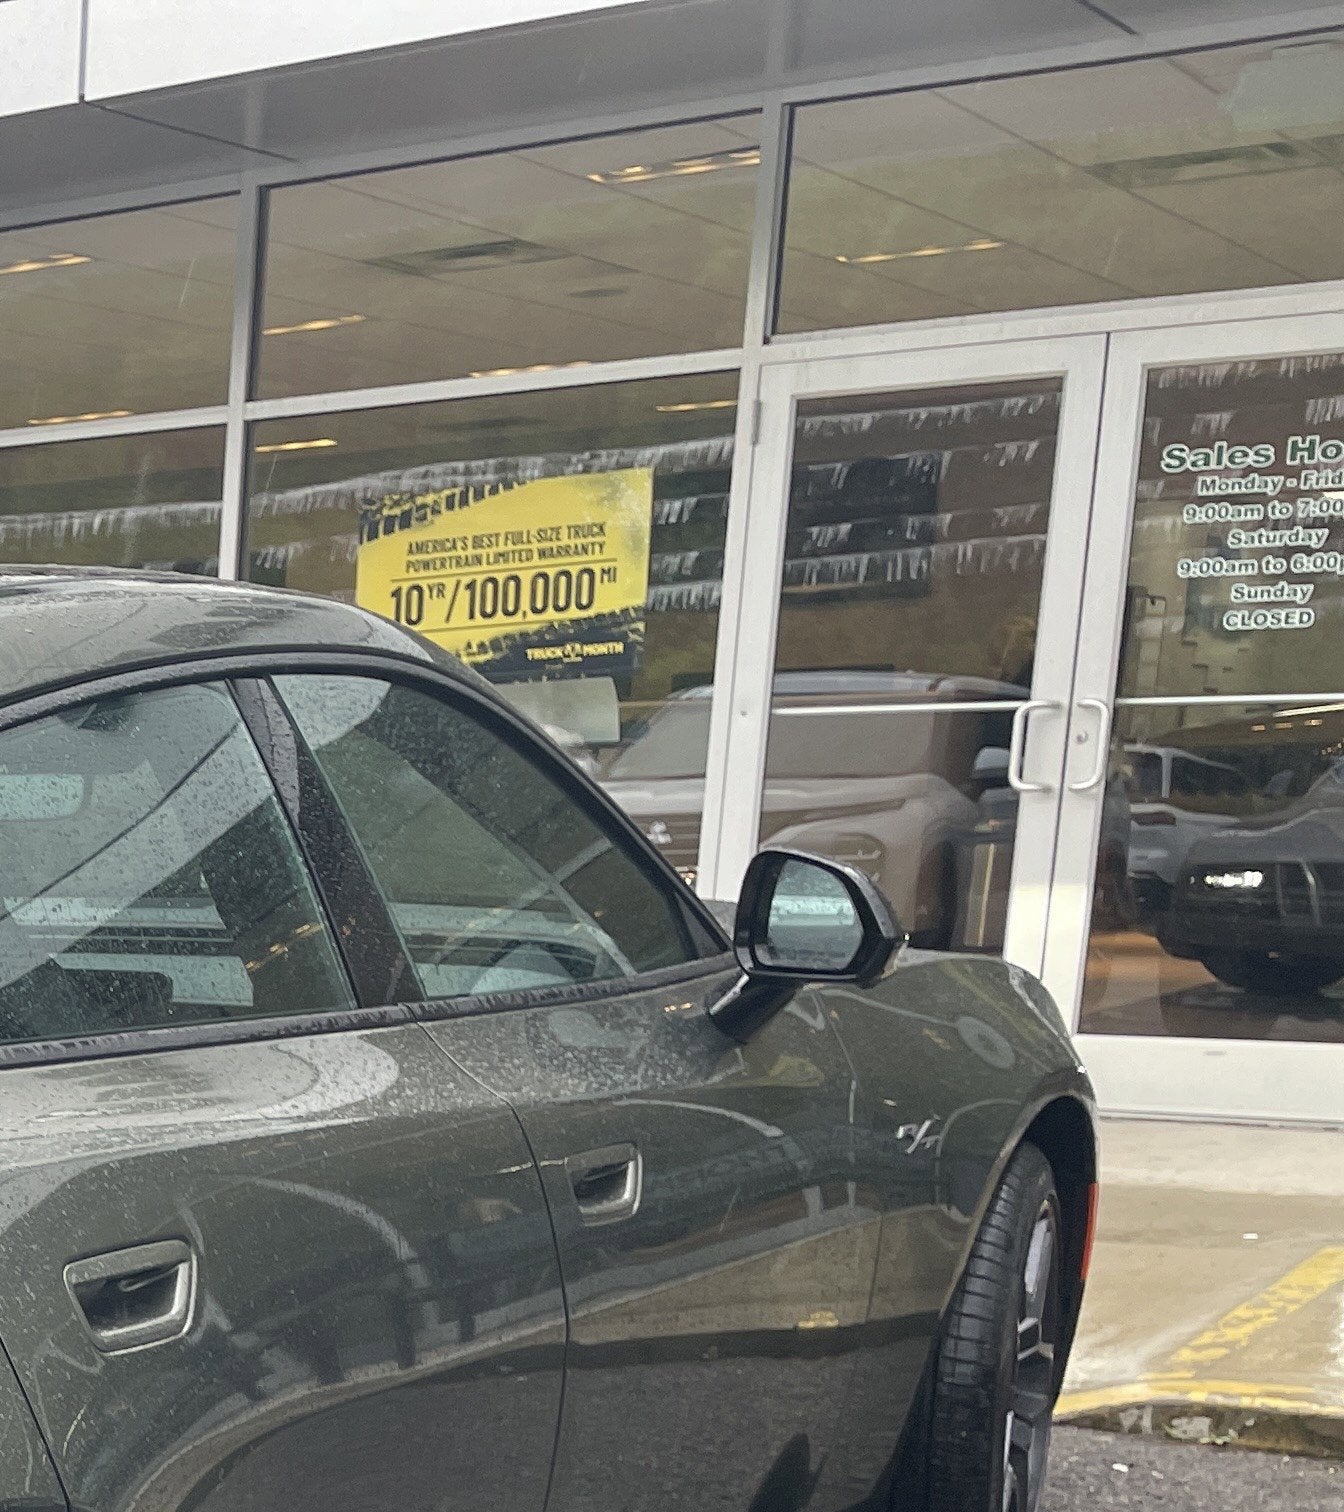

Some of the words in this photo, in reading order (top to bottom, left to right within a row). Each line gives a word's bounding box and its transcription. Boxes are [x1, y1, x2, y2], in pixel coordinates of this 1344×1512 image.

[1161, 441, 1275, 472] Sales
[1197, 474, 1284, 496] Monday
[1183, 502, 1263, 524] 9:00am
[1267, 500, 1293, 520] to
[407, 536, 469, 556] AMERICA'S
[472, 532, 501, 550] BEST
[504, 526, 563, 547] FULL-SIZE
[566, 521, 607, 539] TRUCK
[1227, 526, 1329, 549] Saturday
[405, 553, 482, 574] POWERTRAIN
[485, 548, 533, 566] LIMITED
[537, 541, 607, 560] WARRANTY
[1177, 557, 1258, 578] 9:00am
[1262, 555, 1288, 575] to
[1231, 581, 1314, 604] Sunday
[1223, 608, 1315, 631] CLOSED
